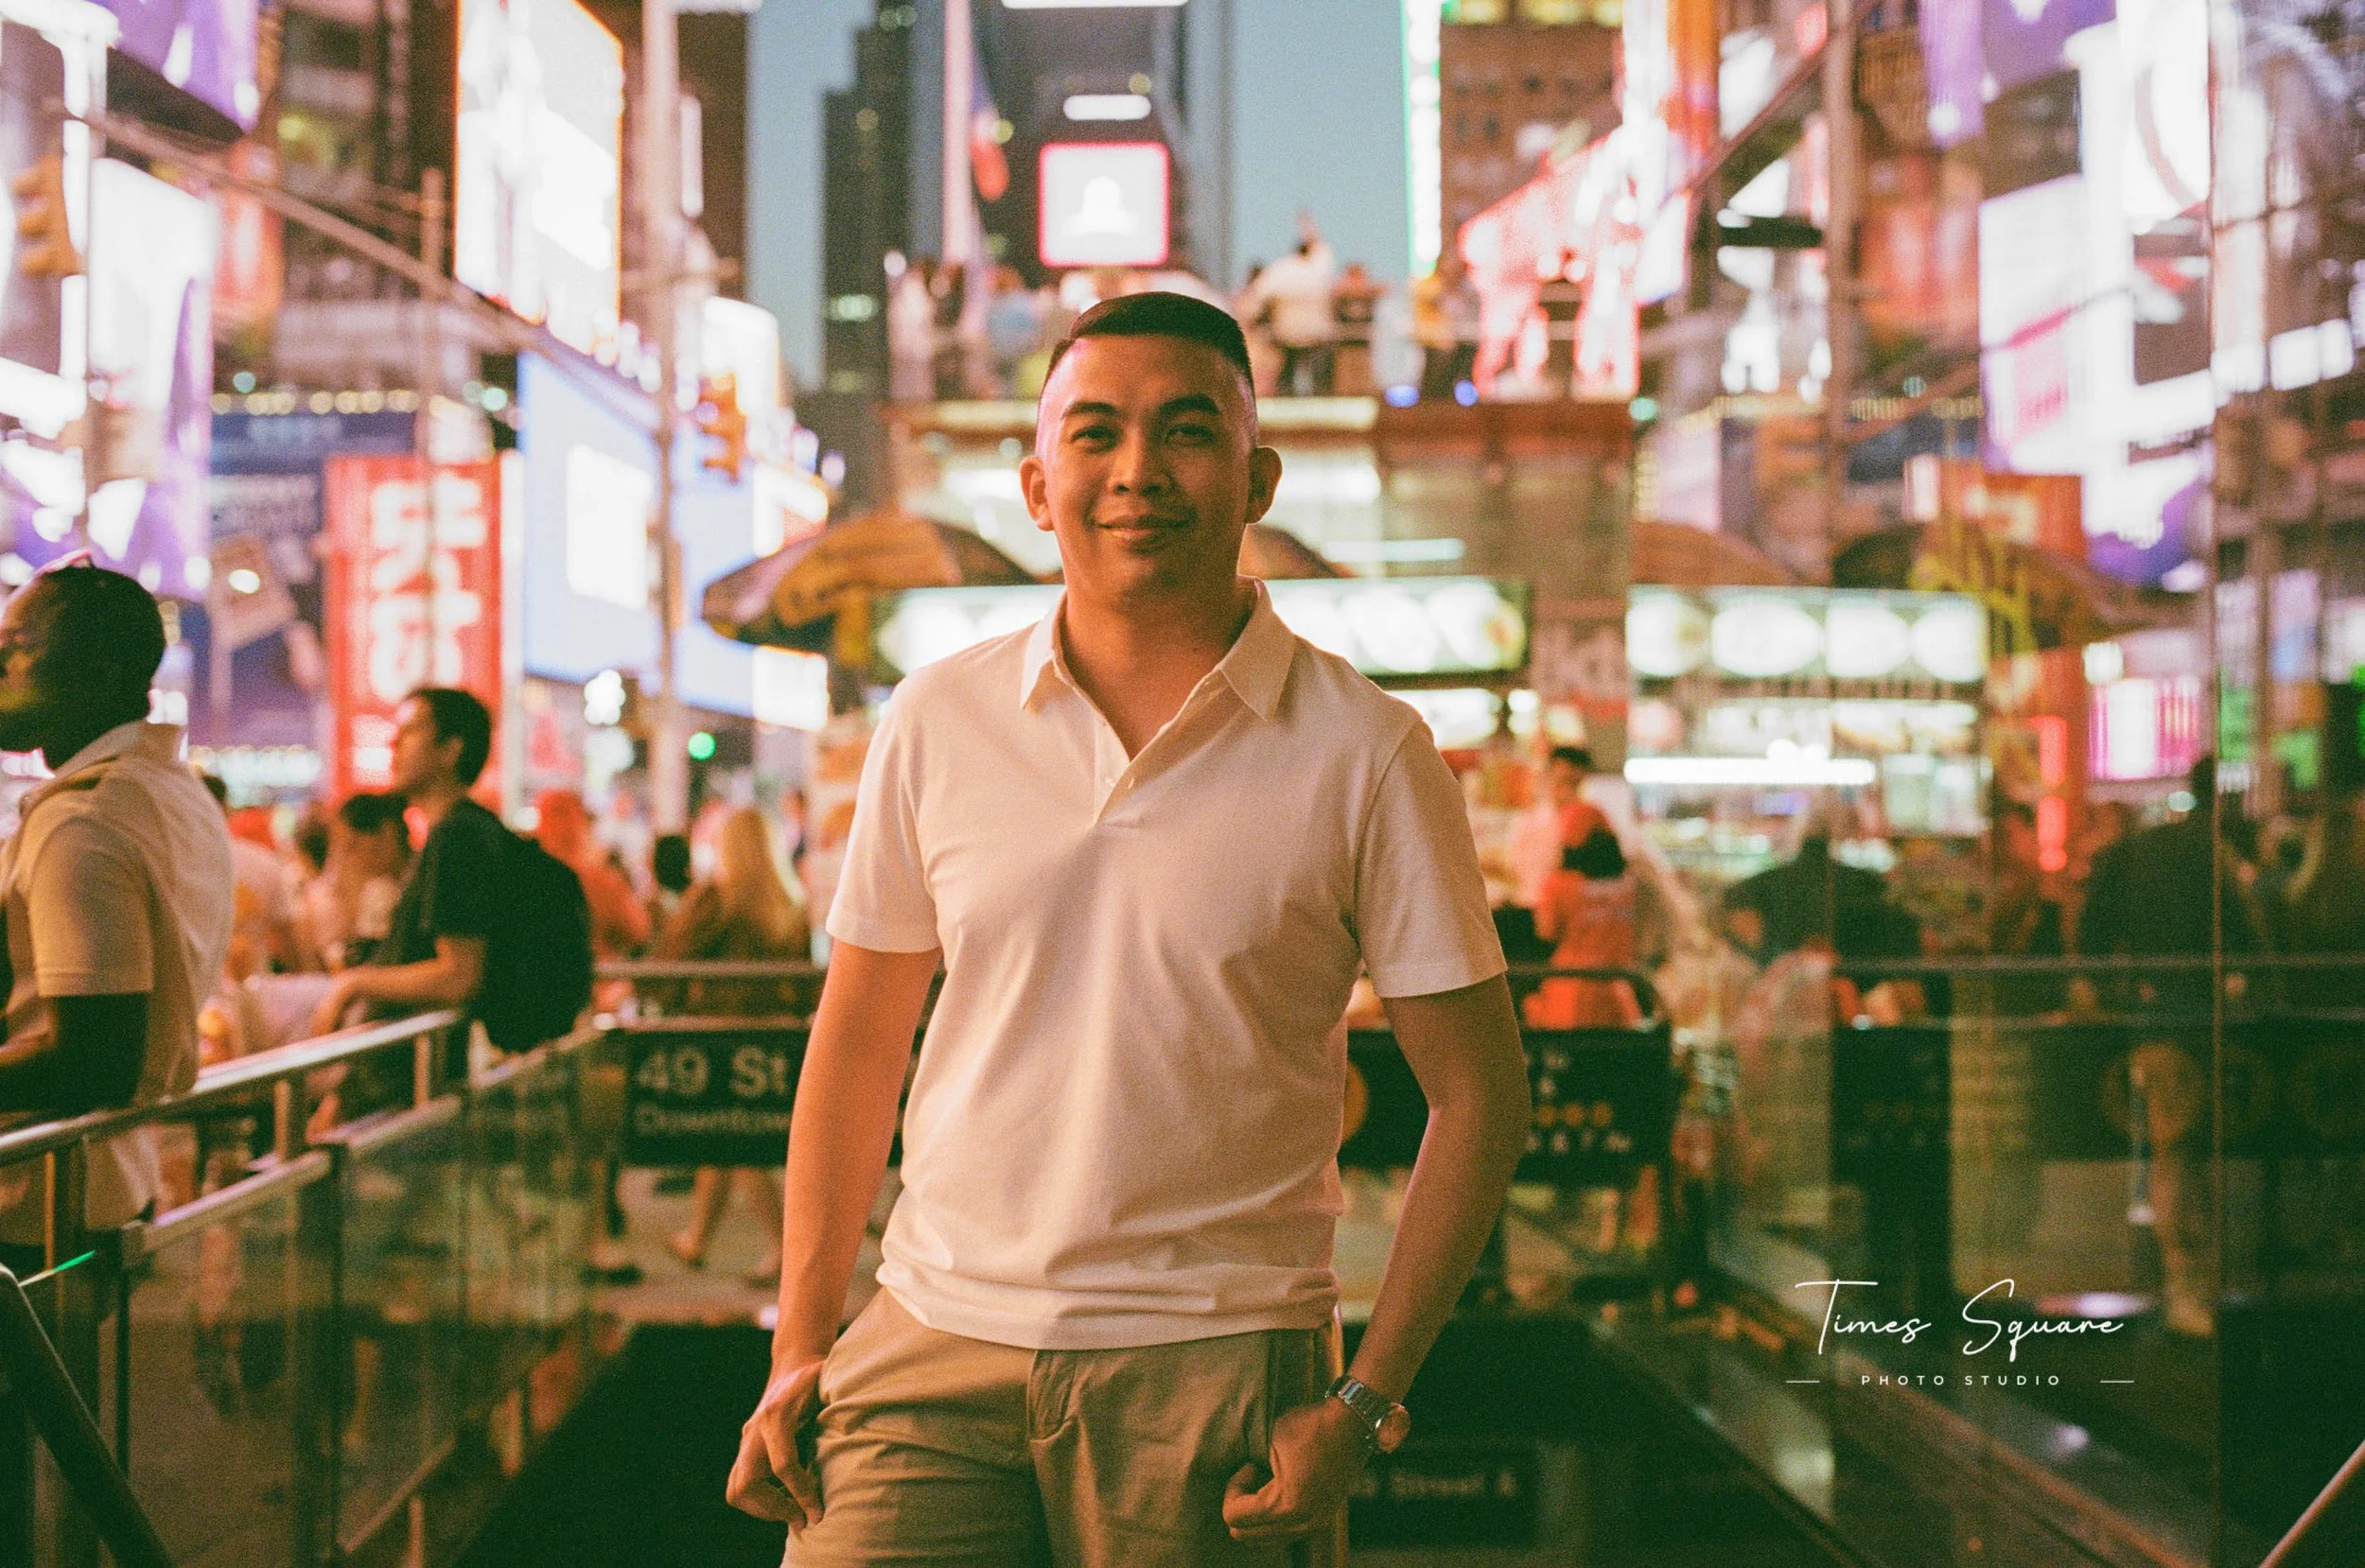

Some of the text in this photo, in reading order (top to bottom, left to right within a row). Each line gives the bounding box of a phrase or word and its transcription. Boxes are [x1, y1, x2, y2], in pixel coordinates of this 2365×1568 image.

[637, 1044, 790, 1099] 49 St
[633, 1101, 793, 1137] Downtow
